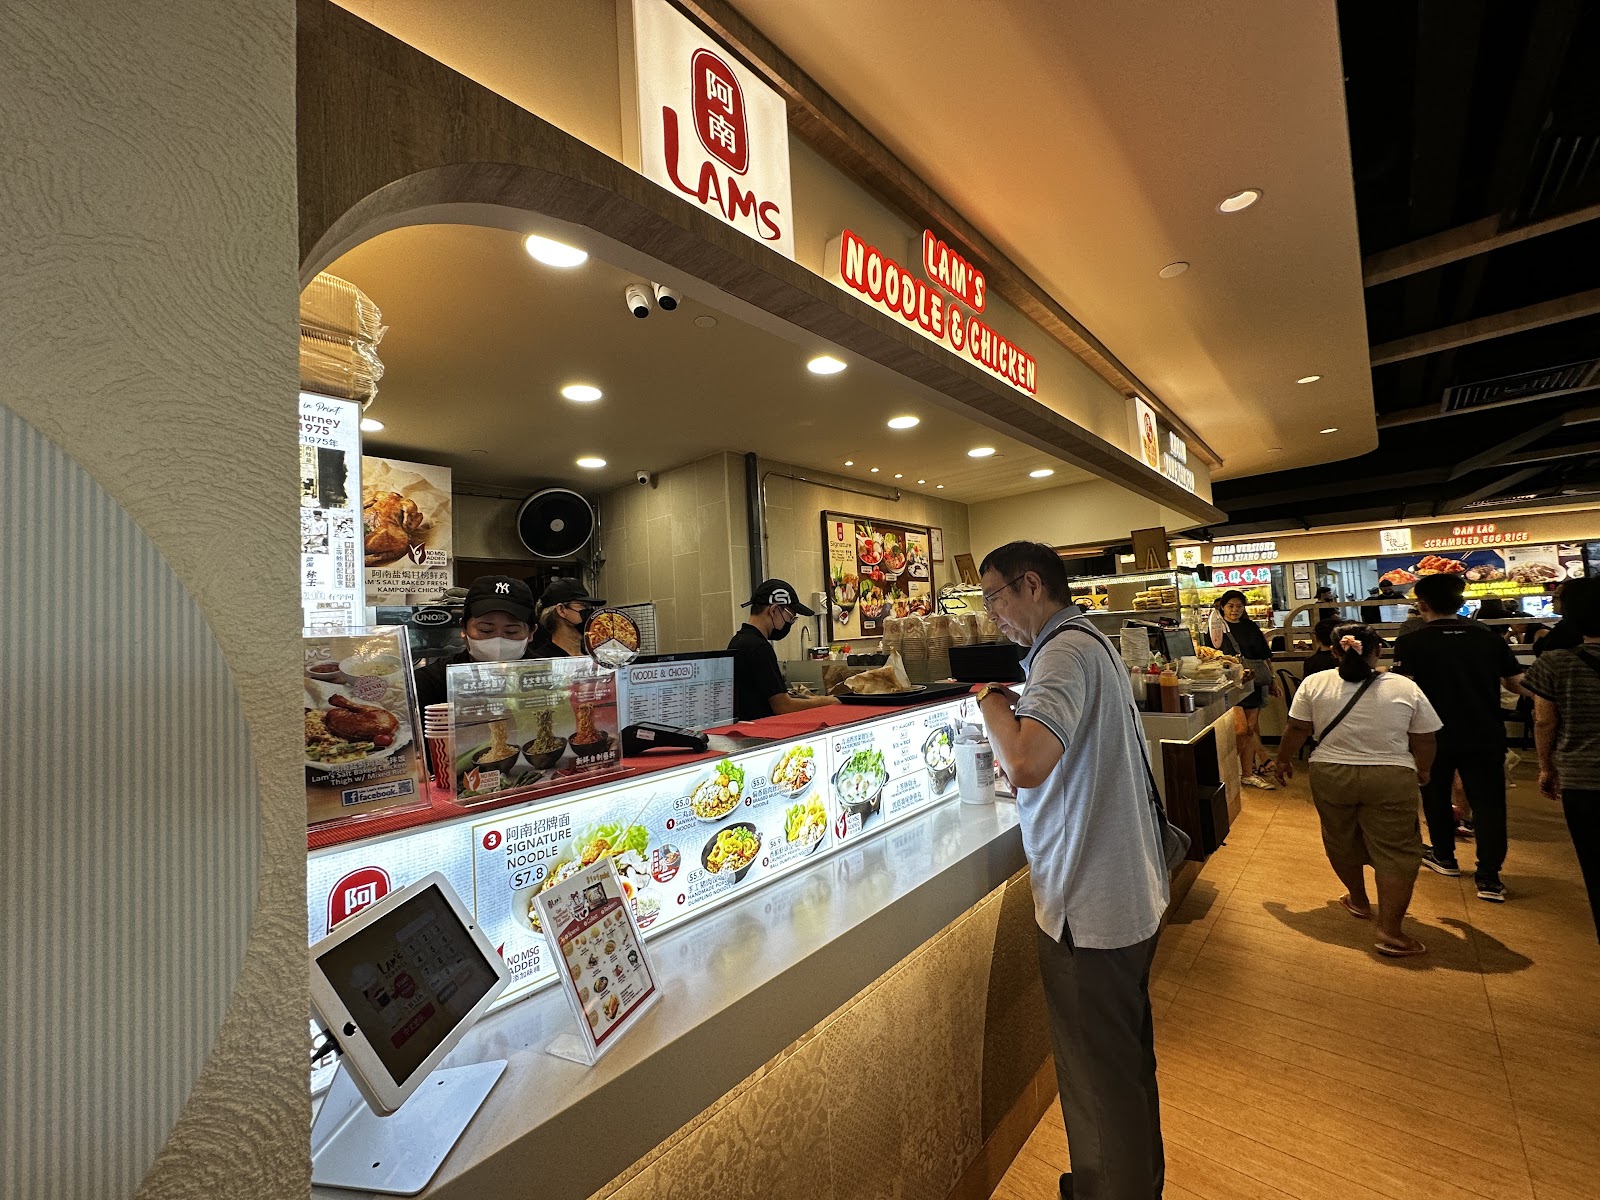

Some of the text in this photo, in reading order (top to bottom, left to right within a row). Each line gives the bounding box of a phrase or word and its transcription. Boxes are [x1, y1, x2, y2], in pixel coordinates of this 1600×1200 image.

[705, 66, 737, 154] 阿南
[663, 105, 781, 241] LAMS
[926, 235, 984, 310] LAM'S
[844, 234, 1036, 392] NOODLE & CHICKEN
[1424, 532, 1528, 548] SCRAMBLED EGG RICE
[1454, 524, 1495, 536] DAN LAO
[1212, 554, 1234, 564] MALA
[1213, 544, 1236, 555] MALA
[632, 670, 658, 680] NOODLE
[660, 669, 666, 678] &
[506, 813, 570, 842] 阿南招牌面
[488, 834, 496, 846] 3
[506, 828, 572, 855] SIGNATURE
[508, 846, 558, 870] NOODLE
[515, 867, 544, 886] $7.8
[507, 945, 539, 966] NO MSG
